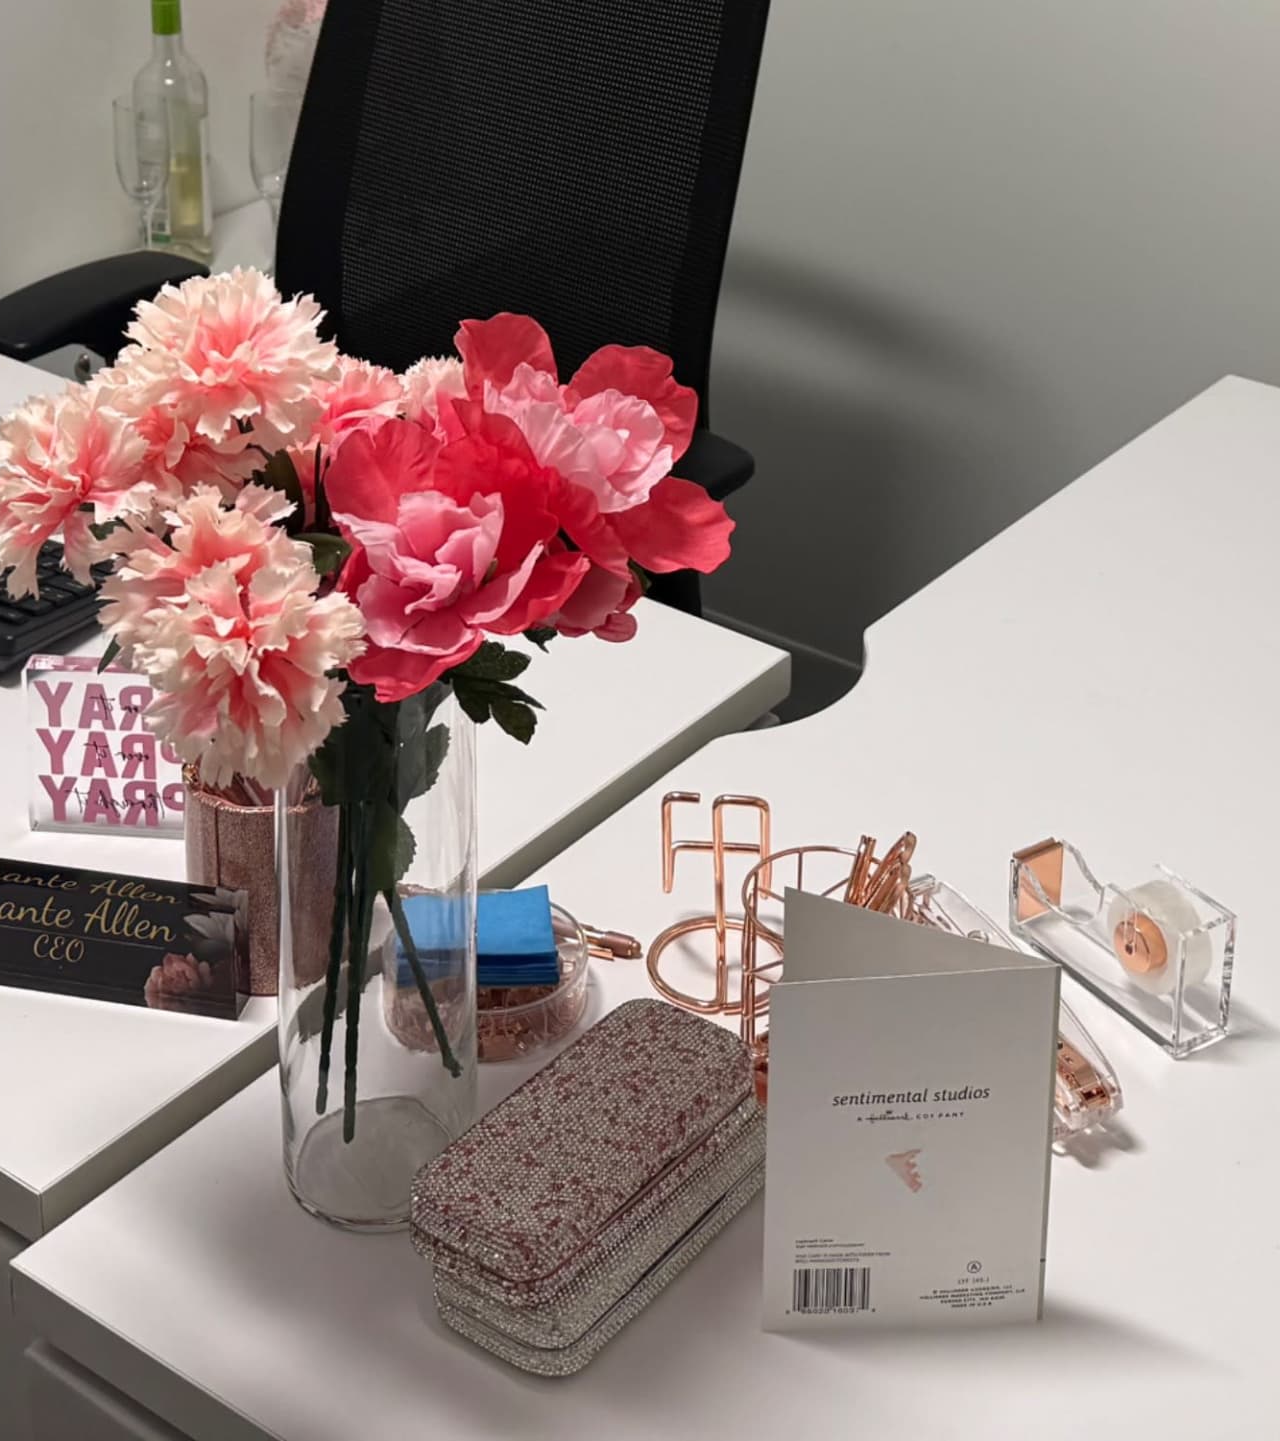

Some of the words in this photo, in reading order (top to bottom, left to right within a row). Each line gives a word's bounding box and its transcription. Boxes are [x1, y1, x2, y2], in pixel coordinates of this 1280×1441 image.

[89, 879, 181, 905] Allen
[83, 898, 176, 942] Allen
[33, 933, 85, 963] CEO
[832, 1088, 928, 1106] sentimental
[933, 1086, 991, 1102] studios
